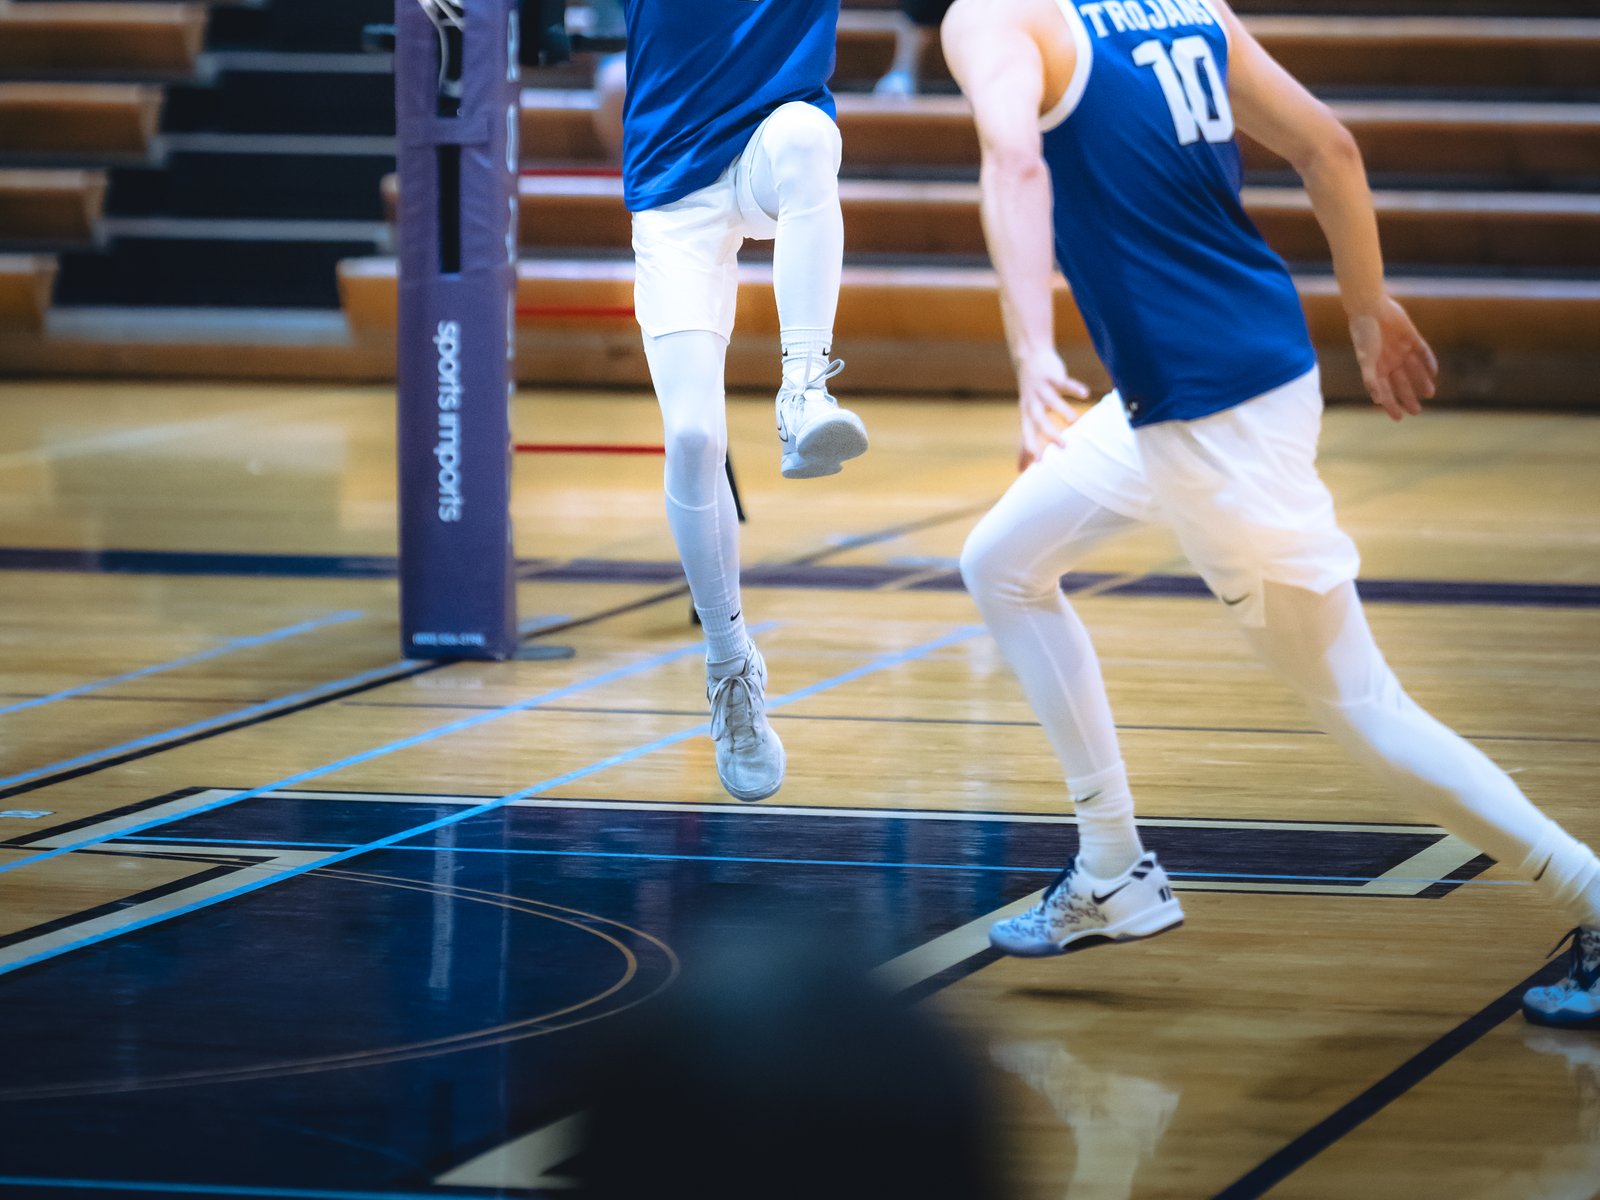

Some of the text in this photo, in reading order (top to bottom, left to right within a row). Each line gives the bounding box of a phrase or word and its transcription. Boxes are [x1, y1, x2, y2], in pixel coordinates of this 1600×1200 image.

[1131, 34, 1235, 146] 10
[432, 319, 464, 523] sports imports
